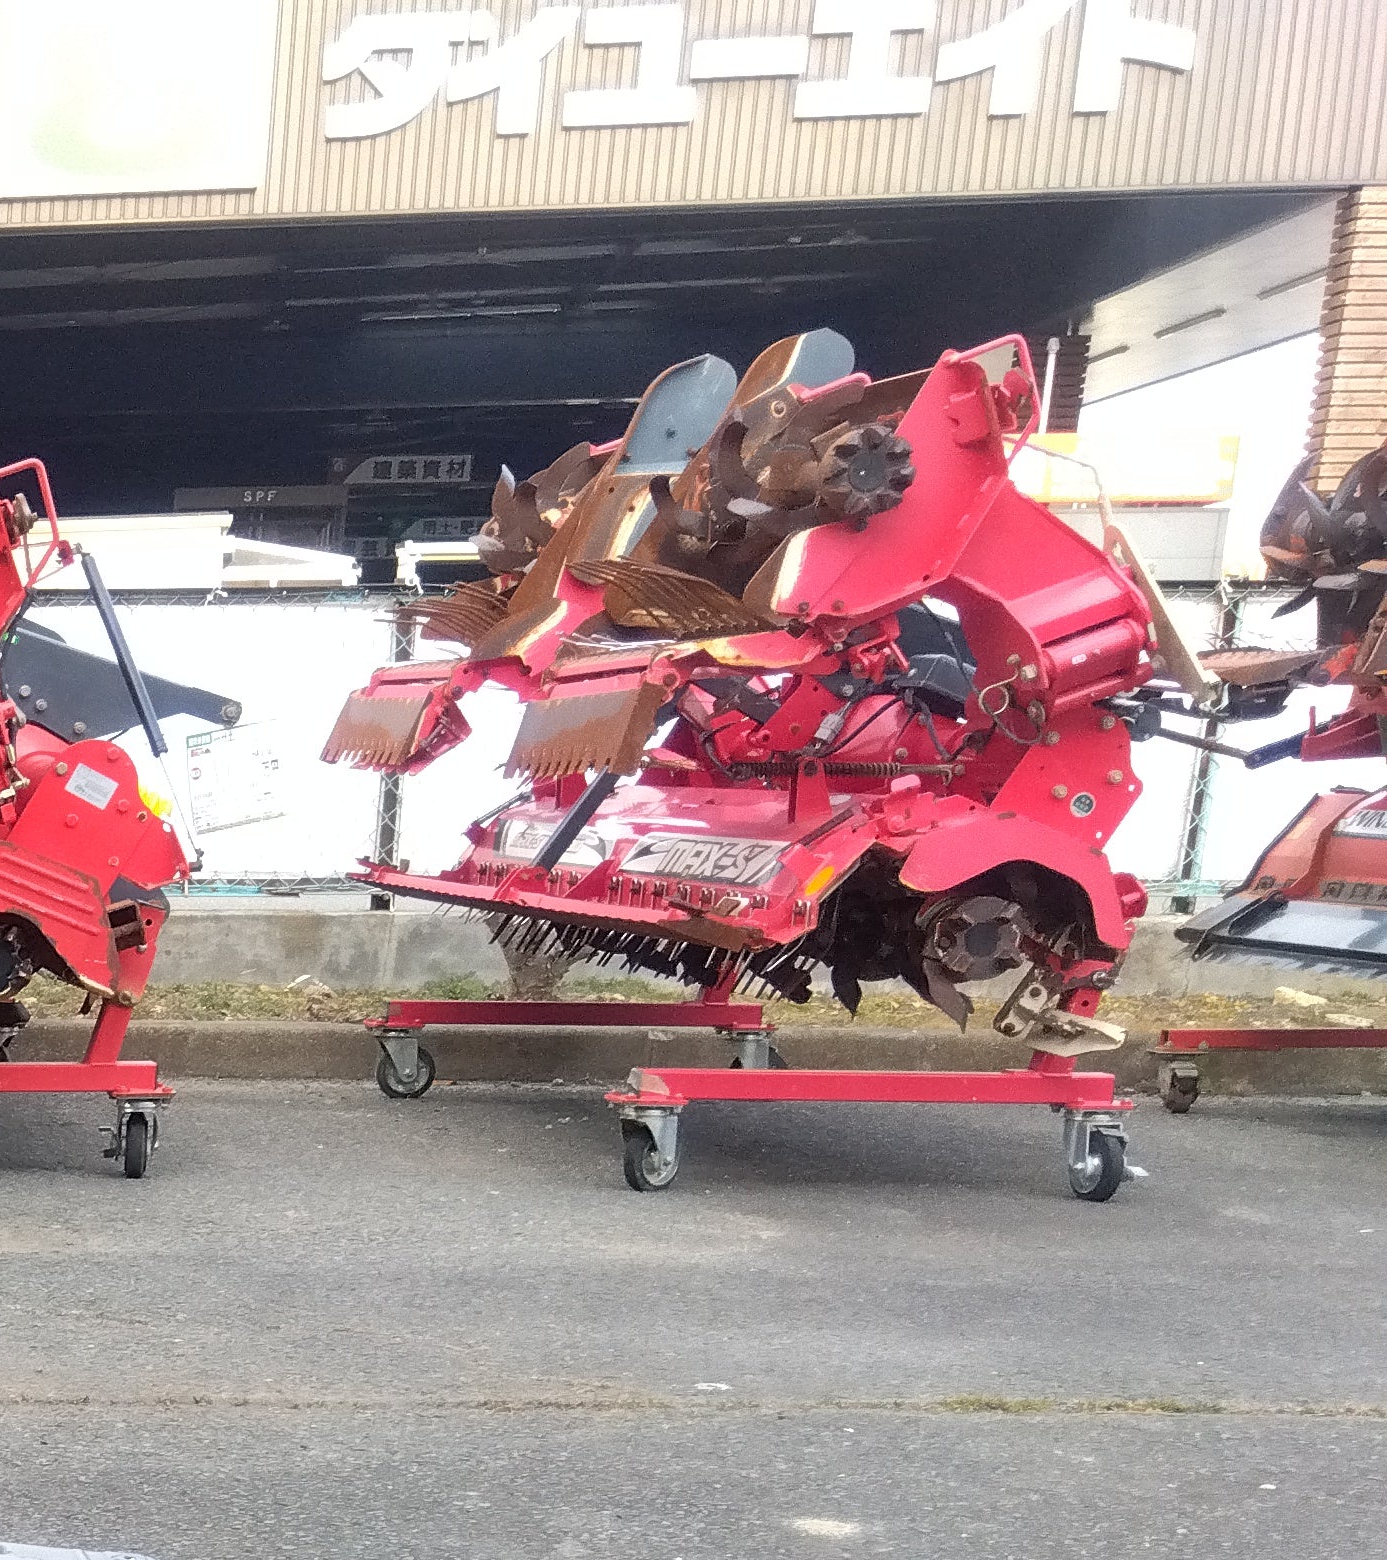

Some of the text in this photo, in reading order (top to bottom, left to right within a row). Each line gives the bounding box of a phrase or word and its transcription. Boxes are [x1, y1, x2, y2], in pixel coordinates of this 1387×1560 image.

[323, 0, 1196, 139] ダイユーエイト
